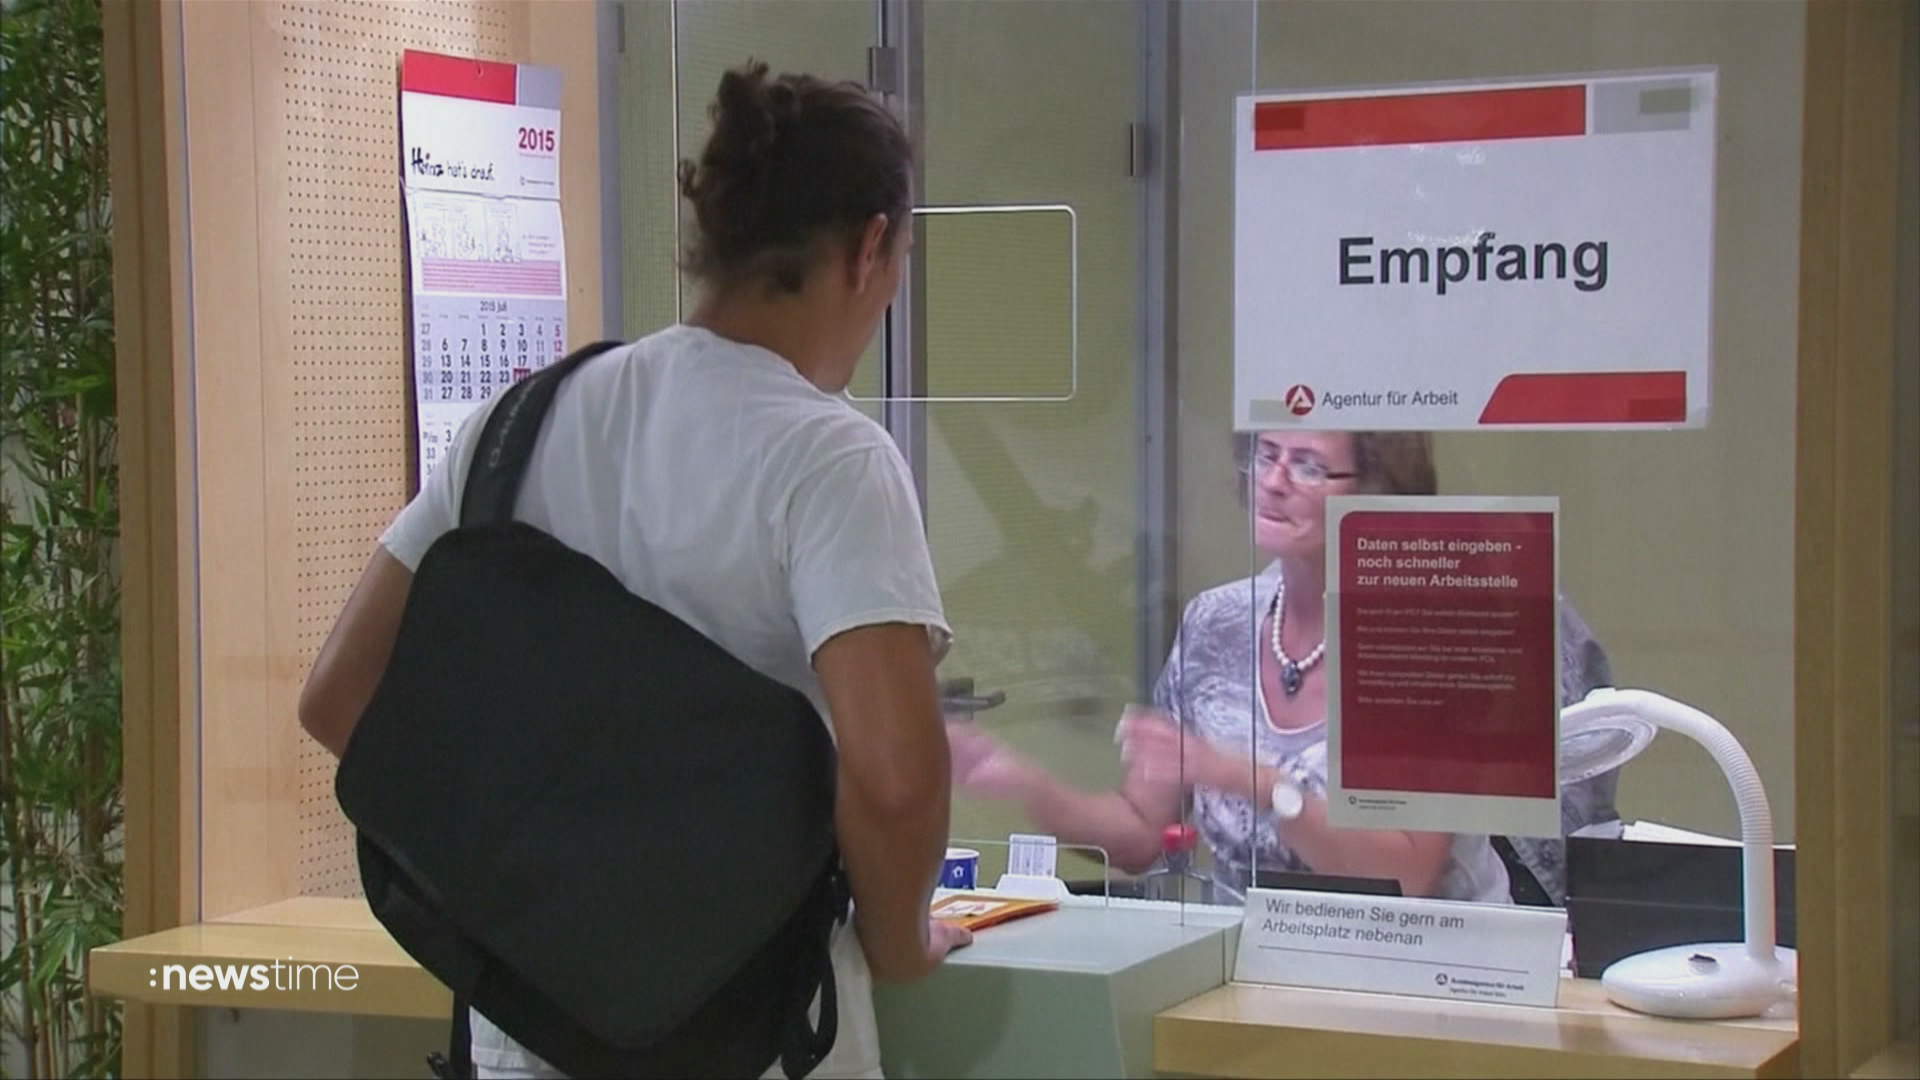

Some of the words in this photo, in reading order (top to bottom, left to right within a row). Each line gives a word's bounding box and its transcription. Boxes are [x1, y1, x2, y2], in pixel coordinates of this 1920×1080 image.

[518, 128, 555, 151] 2015
[1339, 232, 1608, 295] Empfang
[480, 301, 496, 312] 2015
[421, 324, 430, 334] 27
[481, 324, 486, 336] 1
[500, 324, 506, 336] 2
[518, 324, 524, 336] 3
[536, 325, 542, 336] 4
[554, 325, 561, 337] 5
[442, 338, 448, 351] 6
[462, 339, 468, 351] 7
[482, 339, 487, 352] 8
[500, 340, 506, 352] 9
[518, 340, 527, 352] 10
[536, 340, 544, 352] 11
[554, 340, 562, 352] 12
[442, 355, 450, 368] 13
[461, 355, 470, 367] 14
[480, 355, 490, 367] 15
[500, 356, 509, 367] 16
[518, 355, 527, 366] 17
[442, 371, 452, 384] 20
[461, 371, 470, 383] 21
[480, 372, 491, 384] 22
[500, 372, 510, 384] 23
[442, 387, 452, 400] 27
[461, 387, 472, 400] 28
[480, 387, 491, 400] 29
[1322, 392, 1382, 410] Agentur
[1387, 390, 1408, 406] für
[1412, 390, 1458, 406] Arbeit
[446, 429, 452, 442] 3
[1357, 538, 1398, 551] Daten
[1402, 538, 1444, 551] selbst
[1448, 540, 1512, 554] eingeben
[1357, 557, 1392, 568] noch
[1396, 557, 1461, 570] schneller
[1357, 576, 1379, 586] zur
[1383, 576, 1426, 587] neuen
[1430, 574, 1518, 588] Arbeitsstelle
[1266, 899, 1290, 914] Wir
[1295, 902, 1365, 920] bedienen
[1370, 906, 1396, 923] Sie
[1399, 912, 1435, 928] gern
[1439, 916, 1464, 928] am
[1262, 918, 1350, 940] Arbeitsplatz
[1355, 928, 1424, 946] nebenan
